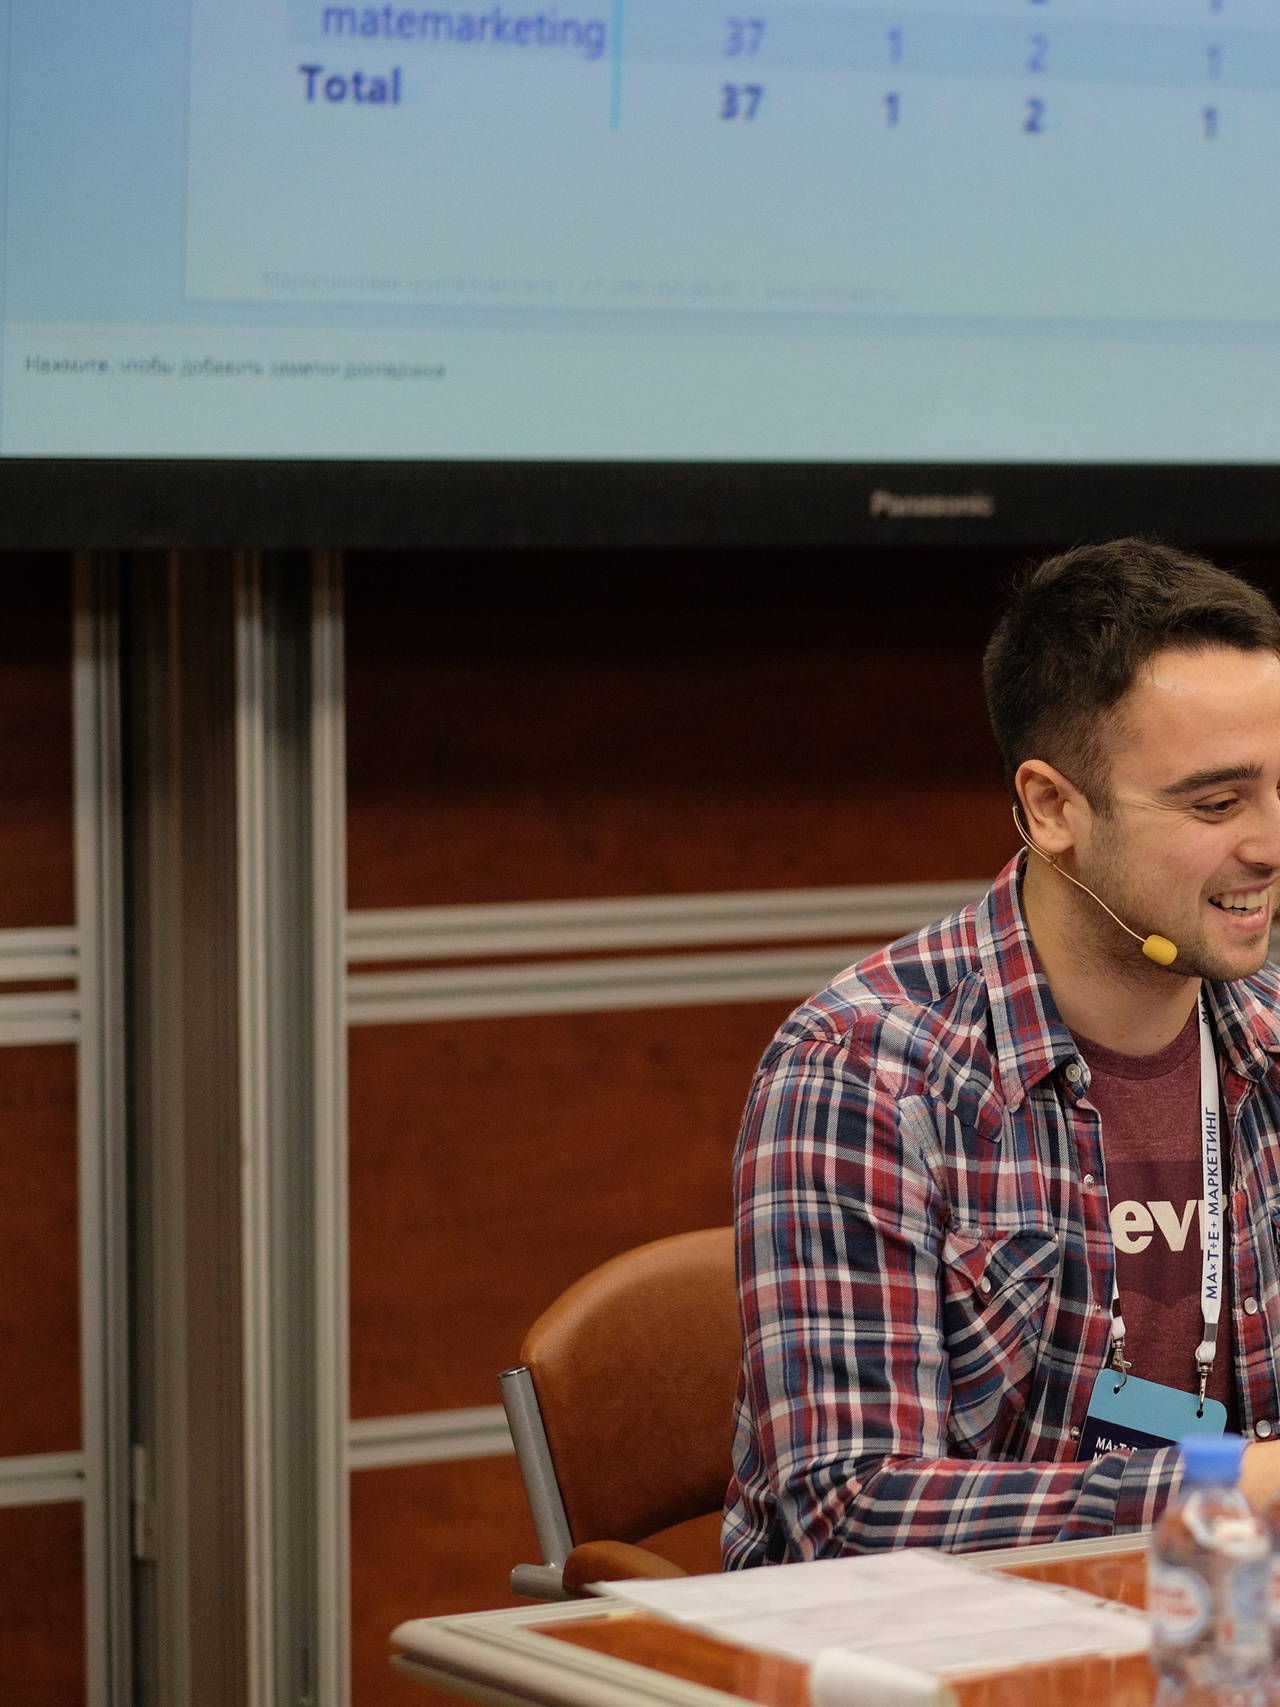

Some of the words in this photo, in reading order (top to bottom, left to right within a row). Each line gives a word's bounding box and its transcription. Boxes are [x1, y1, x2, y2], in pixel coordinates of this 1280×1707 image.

[321, 3, 606, 61] matemarketing
[723, 16, 767, 58] 37
[886, 27, 903, 65] 1
[1026, 32, 1050, 74] 2
[1206, 43, 1223, 80] 1
[299, 64, 402, 106] Total
[720, 82, 764, 121] 37
[884, 91, 900, 128] 1
[1023, 97, 1046, 135] 2
[1202, 105, 1219, 140] 1
